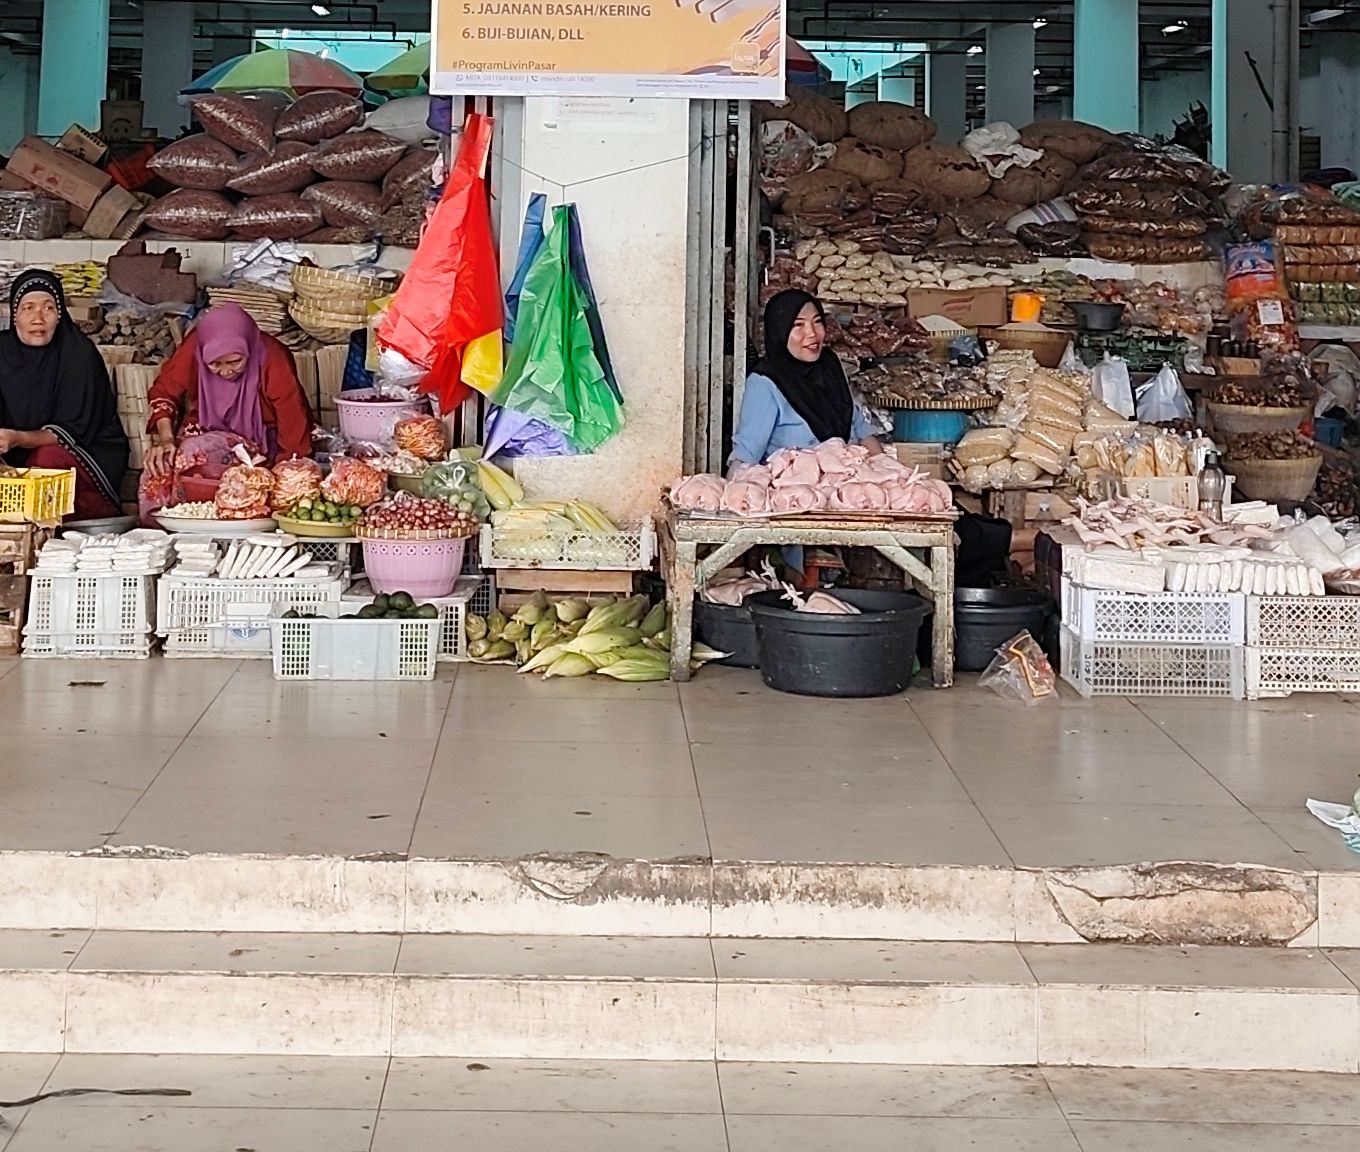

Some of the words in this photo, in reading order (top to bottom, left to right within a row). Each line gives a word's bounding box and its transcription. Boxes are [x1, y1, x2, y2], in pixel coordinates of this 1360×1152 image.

[463, 3, 476, 15] 5.
[477, 3, 542, 17] JAJANAN
[546, 4, 651, 18] BASAH/KERING
[462, 28, 475, 40] 6.
[477, 28, 555, 42] BIJI-BIJIAN,
[558, 29, 584, 41] DLL
[452, 60, 556, 72] #ProgramLivinPasar
